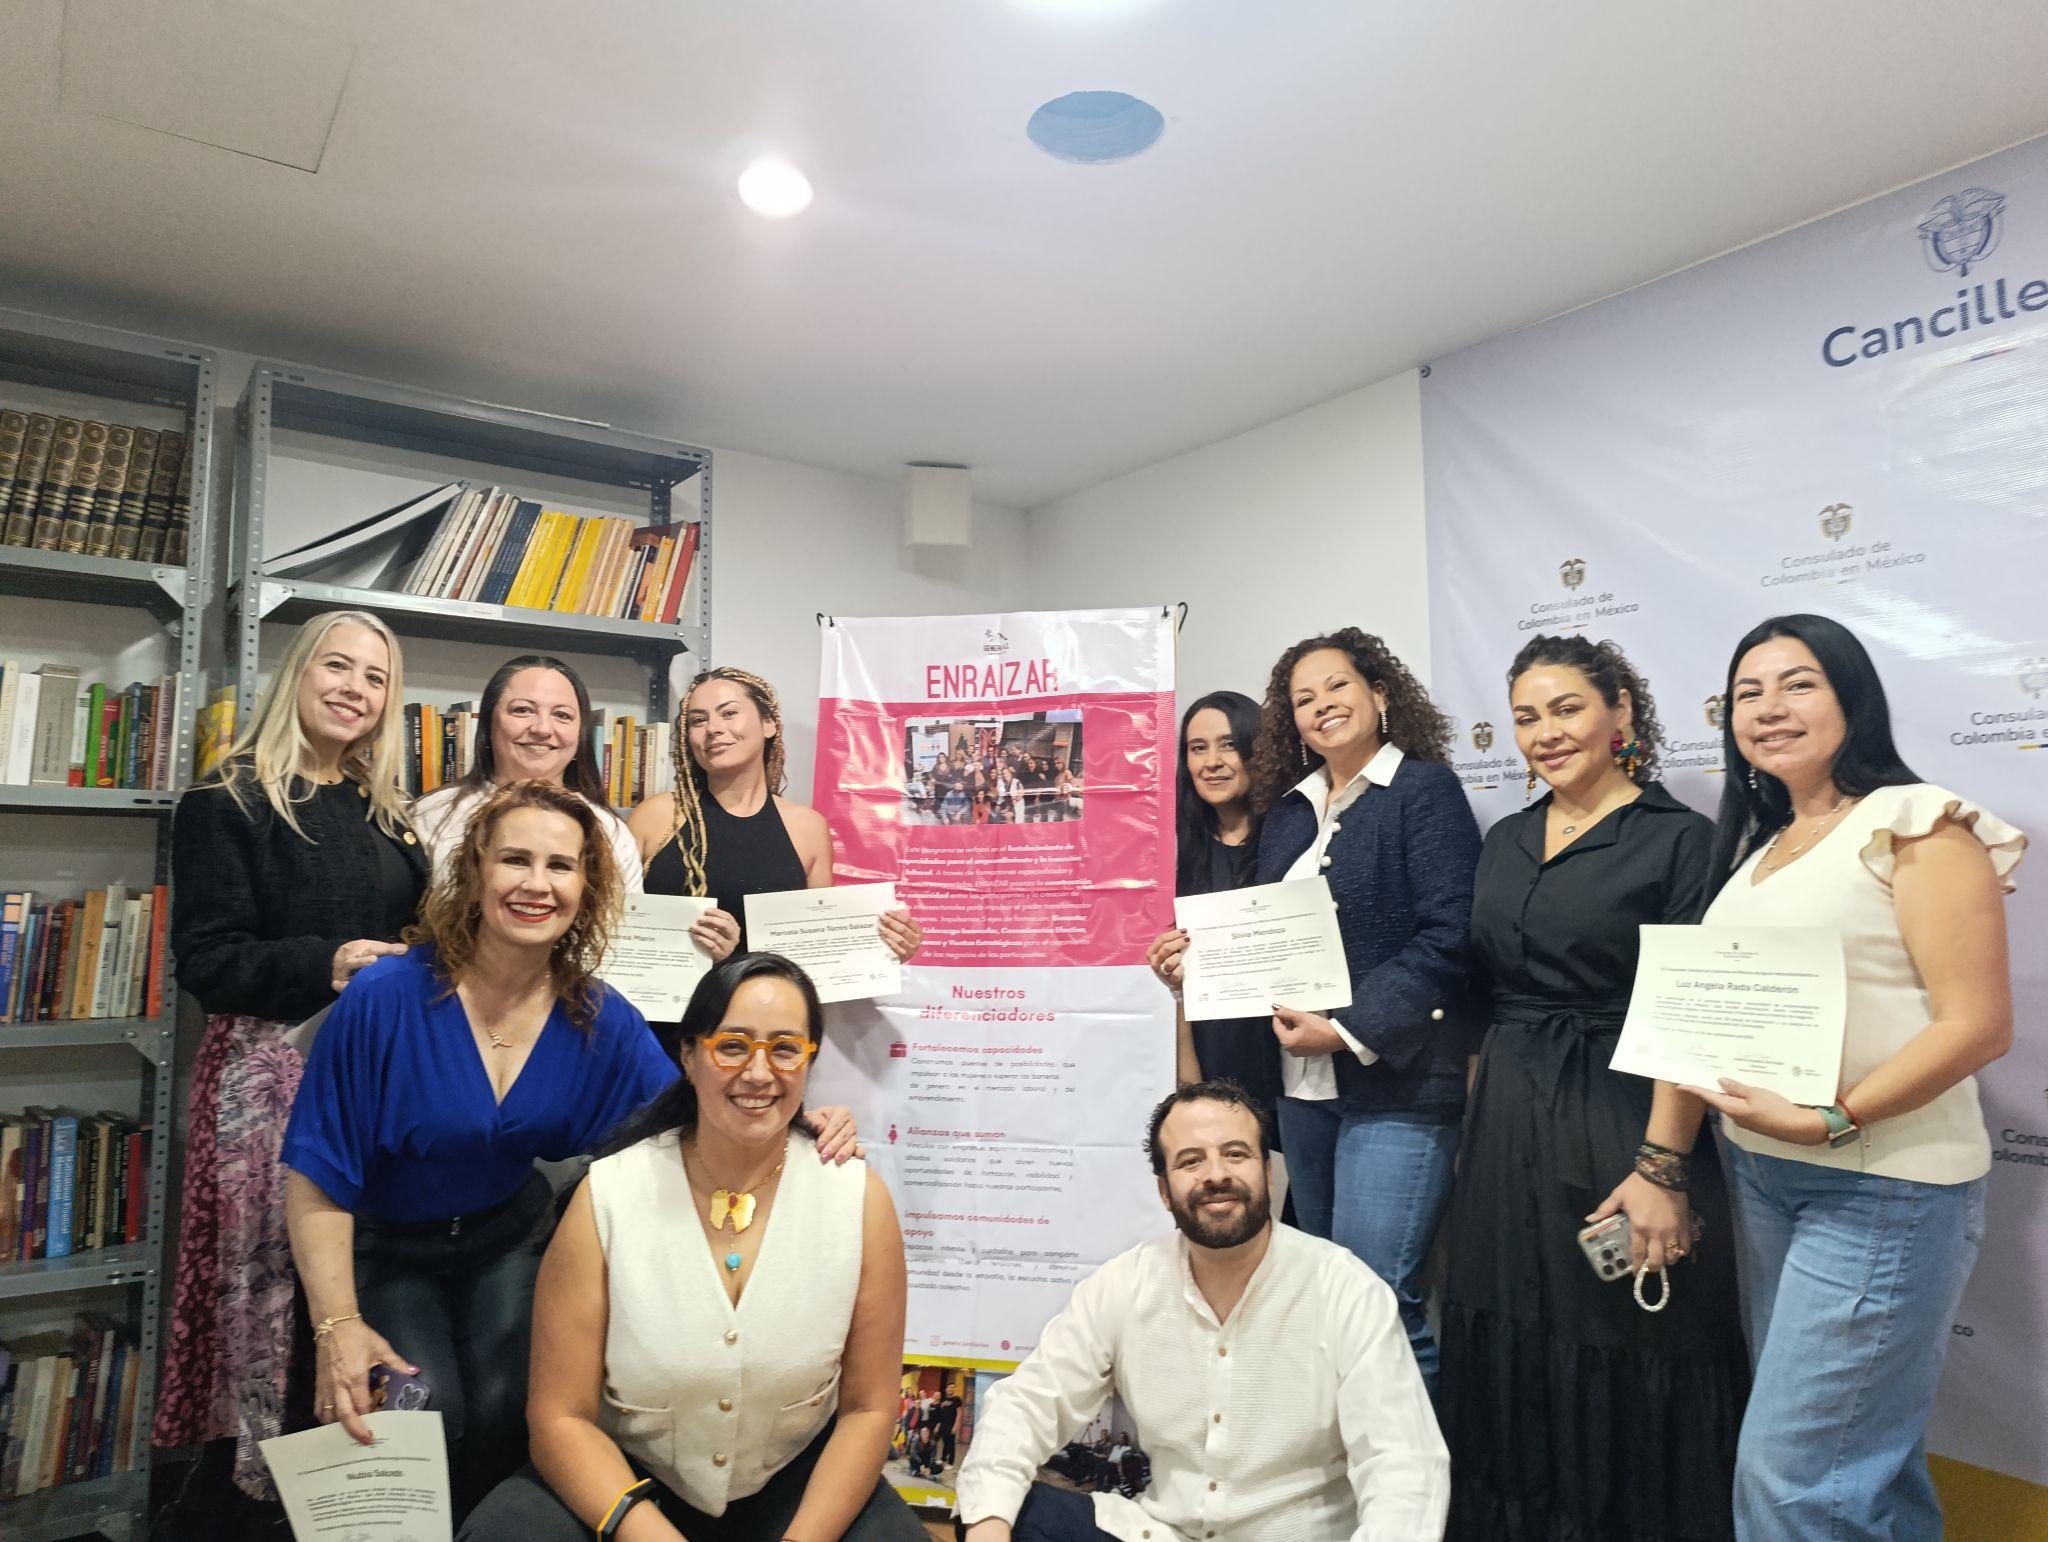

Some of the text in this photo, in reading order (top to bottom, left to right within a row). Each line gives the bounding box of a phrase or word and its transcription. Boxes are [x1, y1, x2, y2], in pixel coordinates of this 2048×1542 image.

[1781, 541, 1891, 568] Consulado de
[1760, 552, 1926, 587] Colombia en México
[1530, 592, 1614, 614] Consulado de
[1518, 602, 1639, 630] Colombia en México
[926, 658, 1058, 699] ENRAIZAR
[1969, 707, 2048, 726] Consula
[1949, 727, 2037, 746] Colombia
[1671, 738, 1725, 752] Consula
[1453, 756, 1518, 771] onsulado de
[1662, 755, 1719, 769] olombia
[1486, 774, 1500, 783] en
[1676, 979, 1691, 988] Luz
[952, 985, 1025, 999] Nuestros
[920, 1005, 1056, 1021] diferenciadores
[912, 1042, 978, 1053] Fortalecemos
[952, 1130, 971, 1141] que
[1992, 1148, 2048, 1168] olomb
[904, 1209, 1050, 1225] Impulsamos comunidades de
[903, 1228, 935, 1240] apoyo
